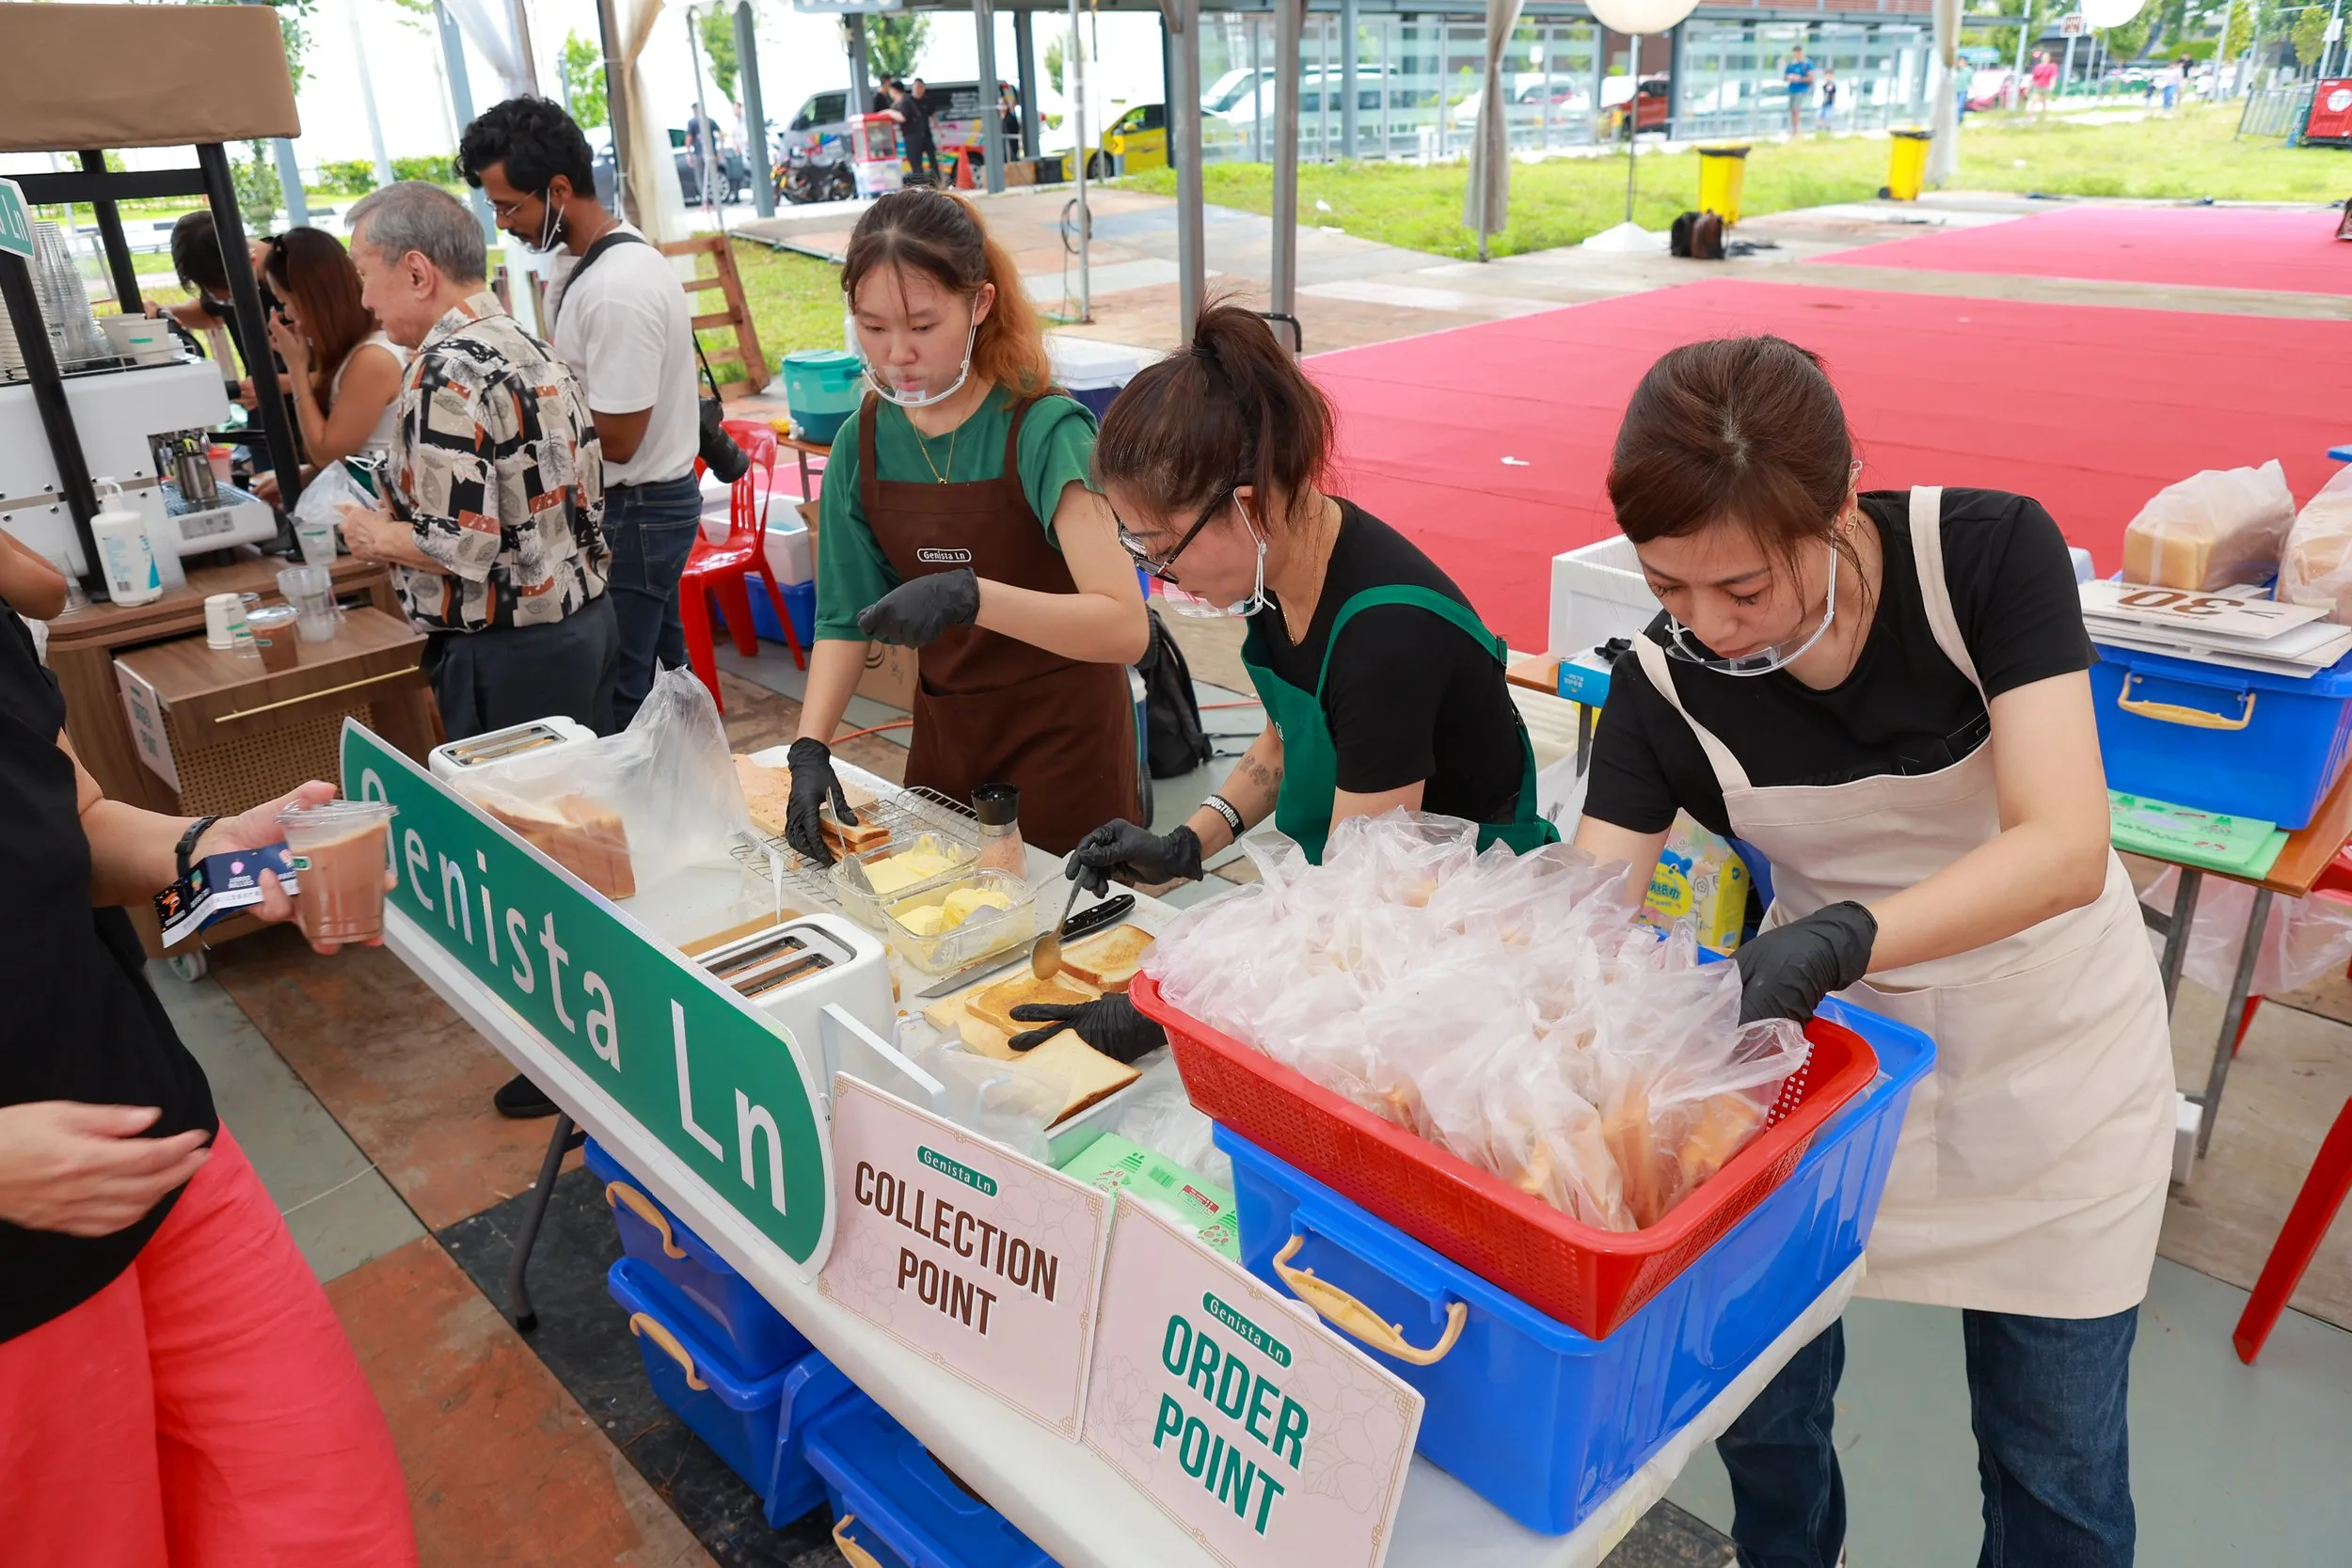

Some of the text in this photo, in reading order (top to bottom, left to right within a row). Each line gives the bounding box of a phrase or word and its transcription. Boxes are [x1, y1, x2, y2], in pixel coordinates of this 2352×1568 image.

[923, 550, 965, 560] Genista Ln
[2118, 590, 2246, 616] 30
[670, 997, 787, 1217] Ln
[923, 1149, 992, 1194] Genista Ln
[854, 1160, 1058, 1303] COLLECTION
[898, 1246, 997, 1337] POINT
[1209, 1298, 1284, 1363] Genista Ln
[1162, 1314, 1310, 1470] ORDER
[1152, 1391, 1286, 1536] POINT
